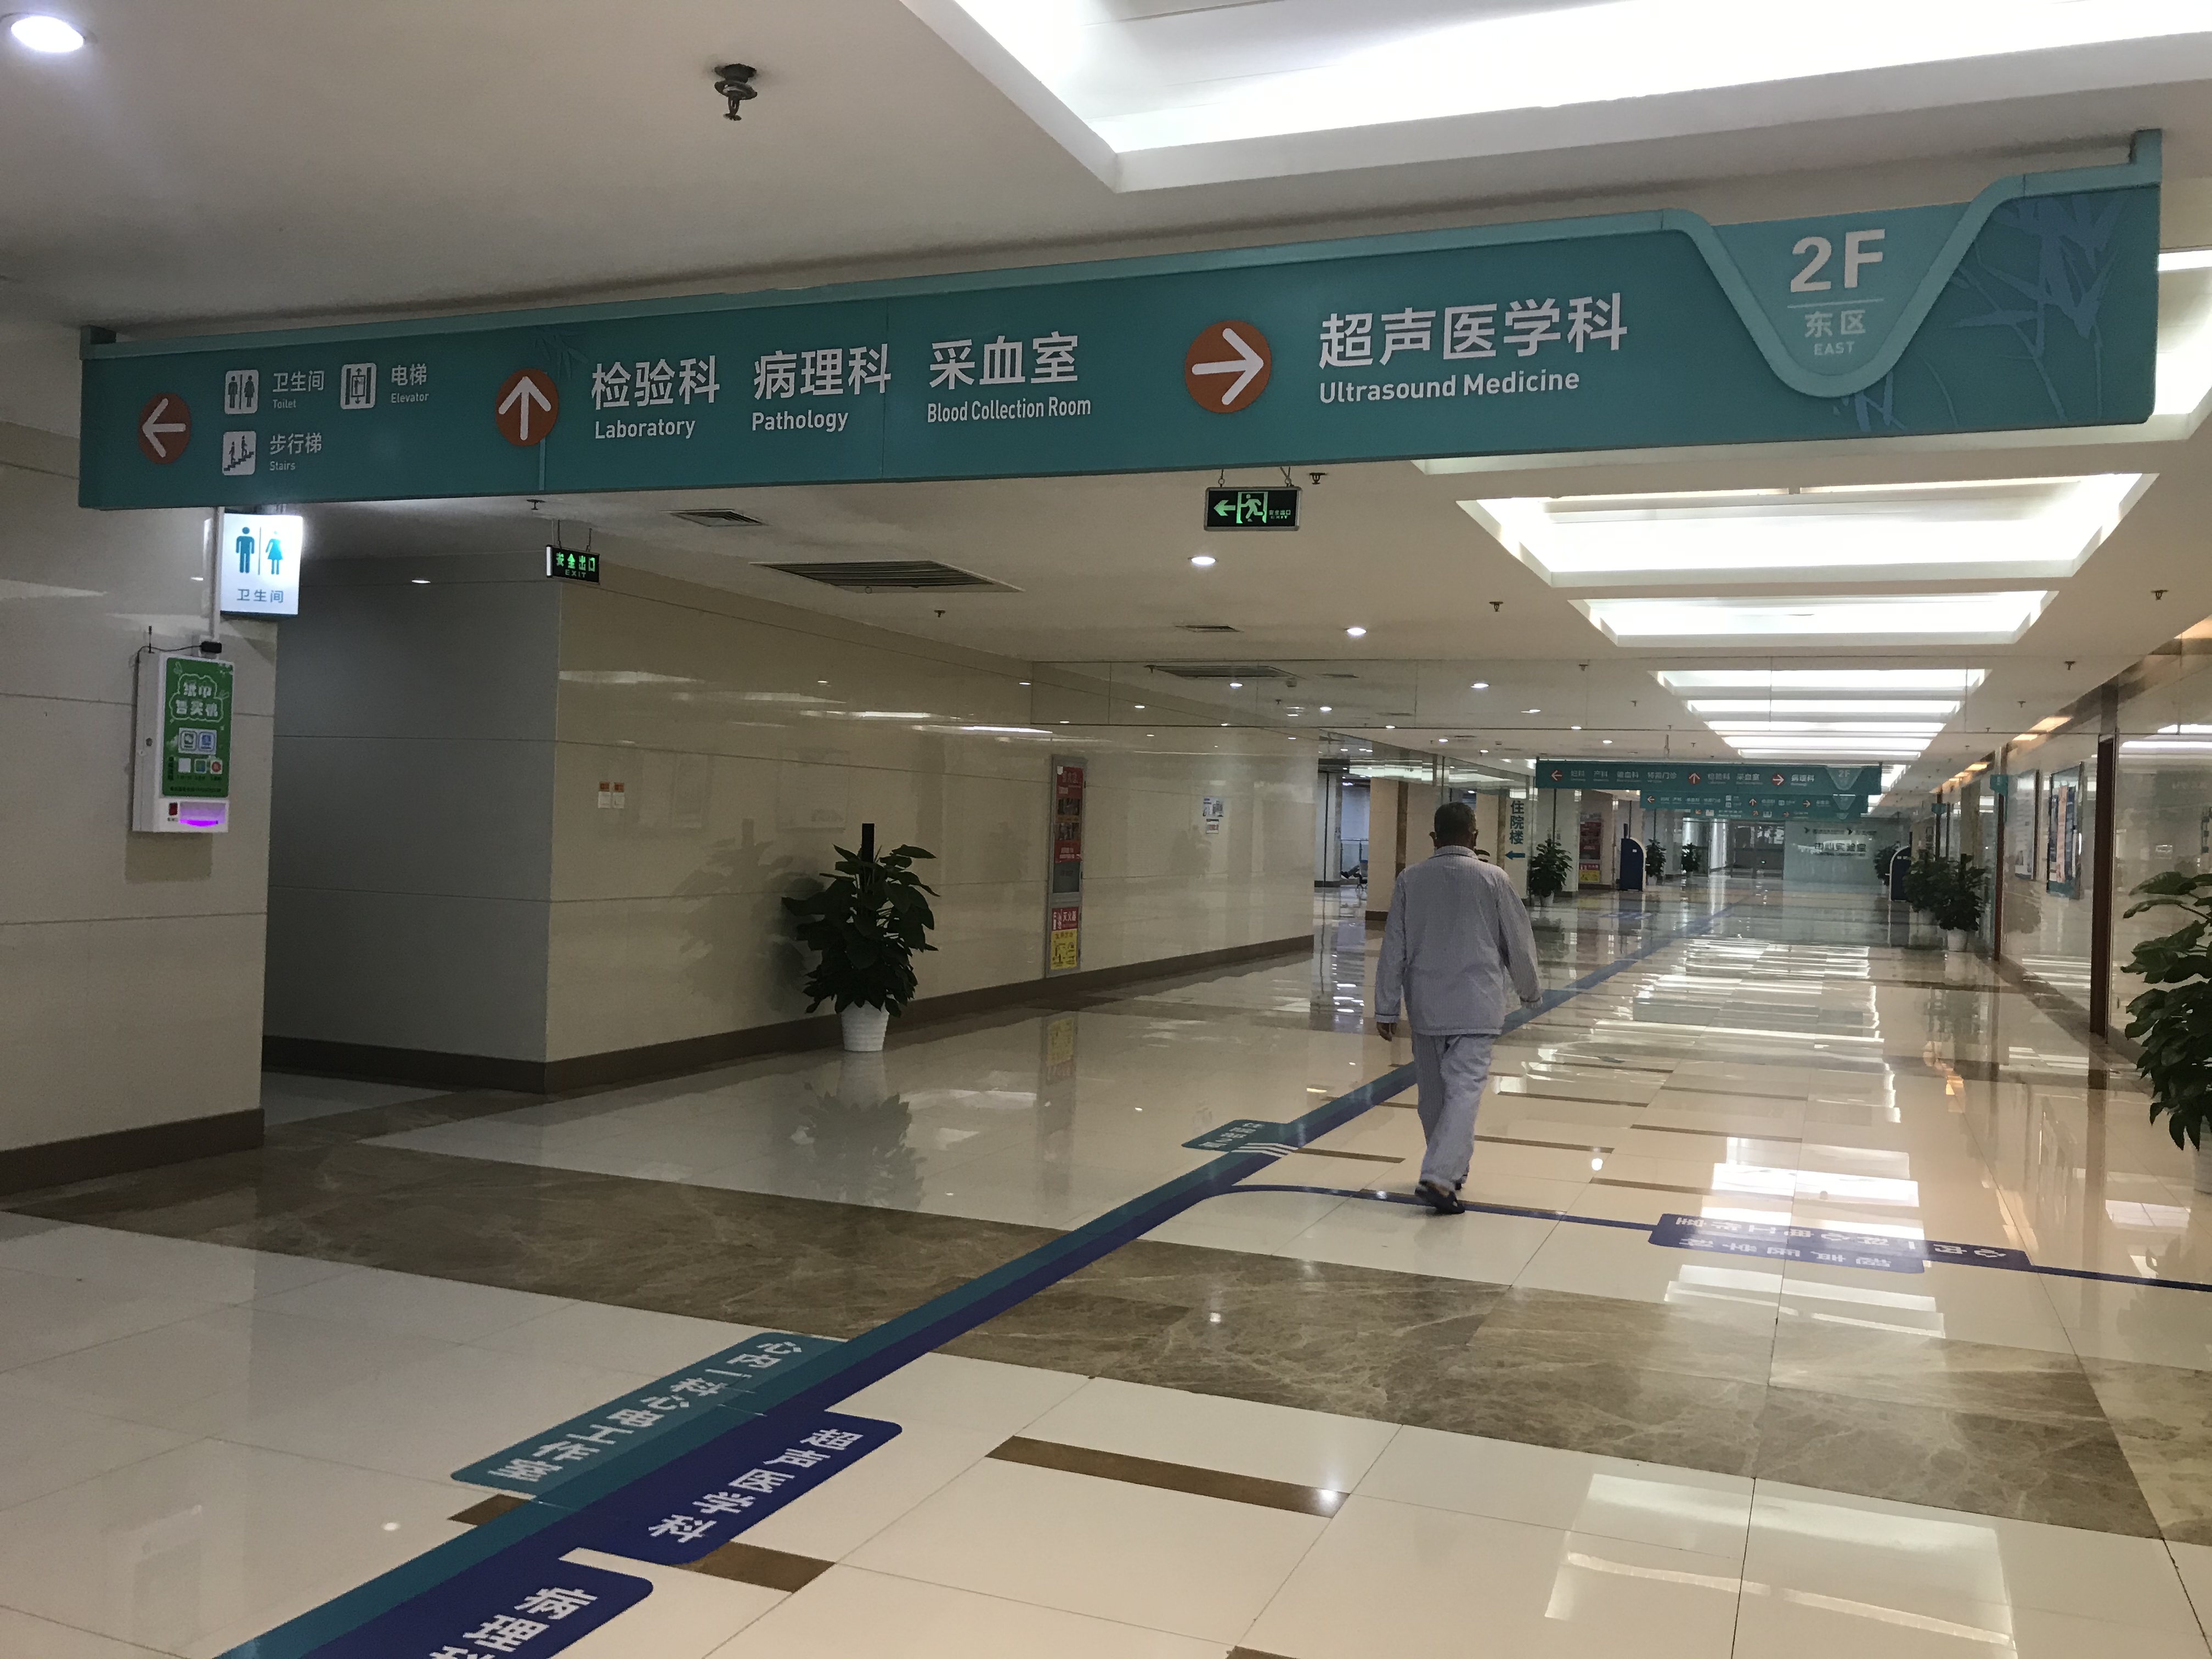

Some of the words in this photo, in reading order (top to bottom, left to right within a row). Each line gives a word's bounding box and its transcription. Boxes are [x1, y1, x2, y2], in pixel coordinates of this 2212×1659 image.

[1790, 229, 1886, 293] 2F
[1318, 292, 1628, 370] 超声医学科
[1804, 309, 1866, 338] 东区
[1814, 341, 1855, 356] EAST
[753, 343, 891, 400] 病理科
[929, 331, 1079, 390] 采血室
[272, 370, 325, 393] 卫生间
[391, 363, 427, 386] 电梯
[591, 355, 720, 410] 检验科
[391, 392, 430, 404] Elevator
[1319, 375, 1457, 404] Ultrasound
[1463, 369, 1580, 396] Medicine
[272, 398, 297, 409] Toilet
[927, 401, 968, 423] Blood
[971, 398, 1045, 420] Collection
[1048, 396, 1091, 416] Room
[595, 418, 696, 439] Laboratory
[752, 409, 849, 432] Pathology
[269, 432, 323, 455] 步行梯
[269, 460, 296, 471] Stairs
[556, 552, 595, 572] 安全出口
[565, 569, 586, 578] EXIT
[236, 588, 284, 603] 卫生间
[1509, 800, 1525, 845] 住院楼
[486, 1340, 802, 1483] 心内一科心电工作室
[647, 1427, 865, 1544] 超声医学科
